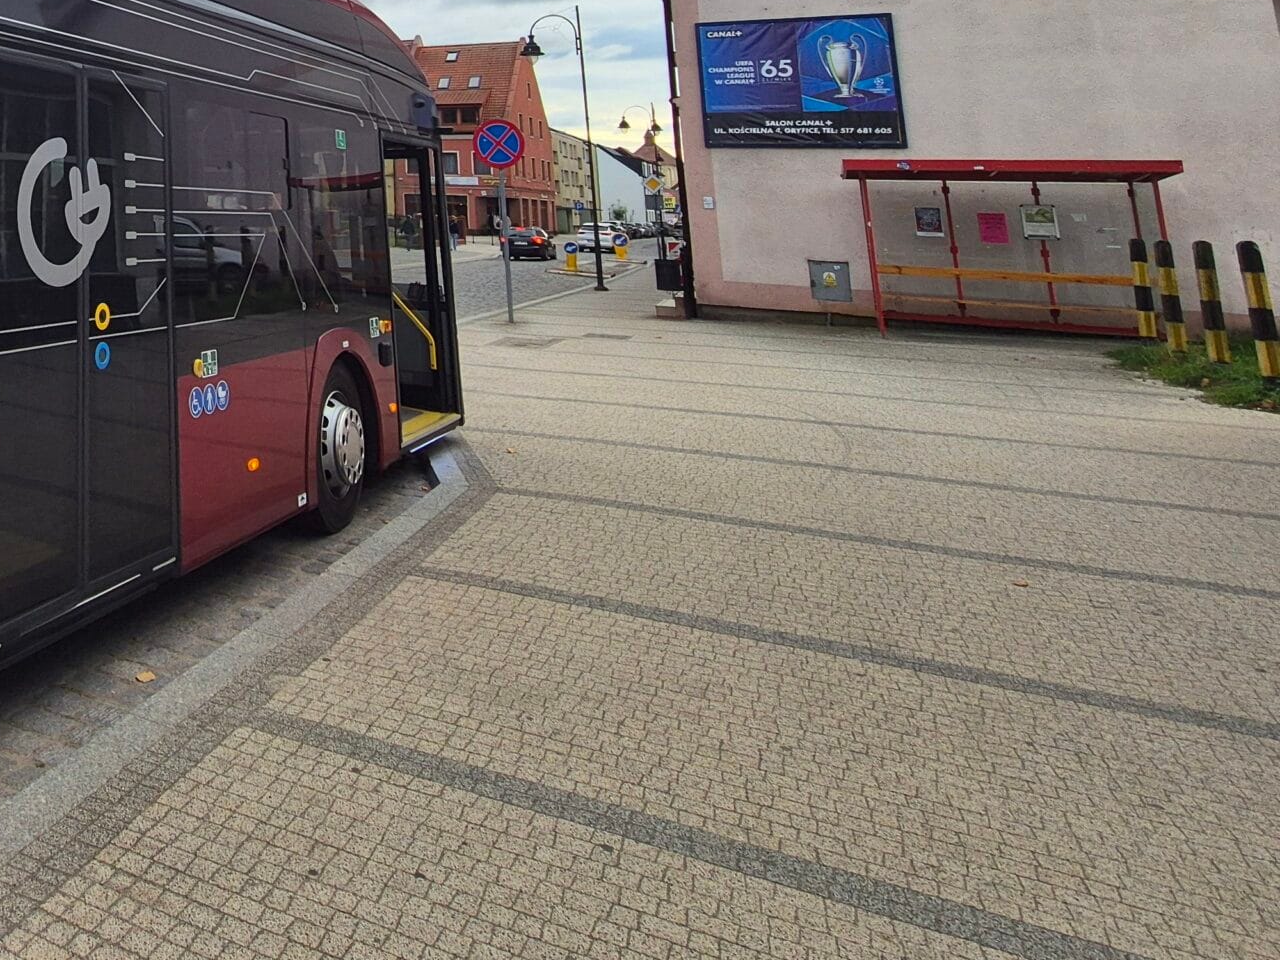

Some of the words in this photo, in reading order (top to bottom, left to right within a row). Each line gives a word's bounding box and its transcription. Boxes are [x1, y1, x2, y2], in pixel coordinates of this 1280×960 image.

[707, 30, 743, 38] CANAL+
[760, 59, 793, 78] 65
[728, 126, 773, 134] KOŚCIELNA
[784, 127, 821, 135] GRYFICE,
